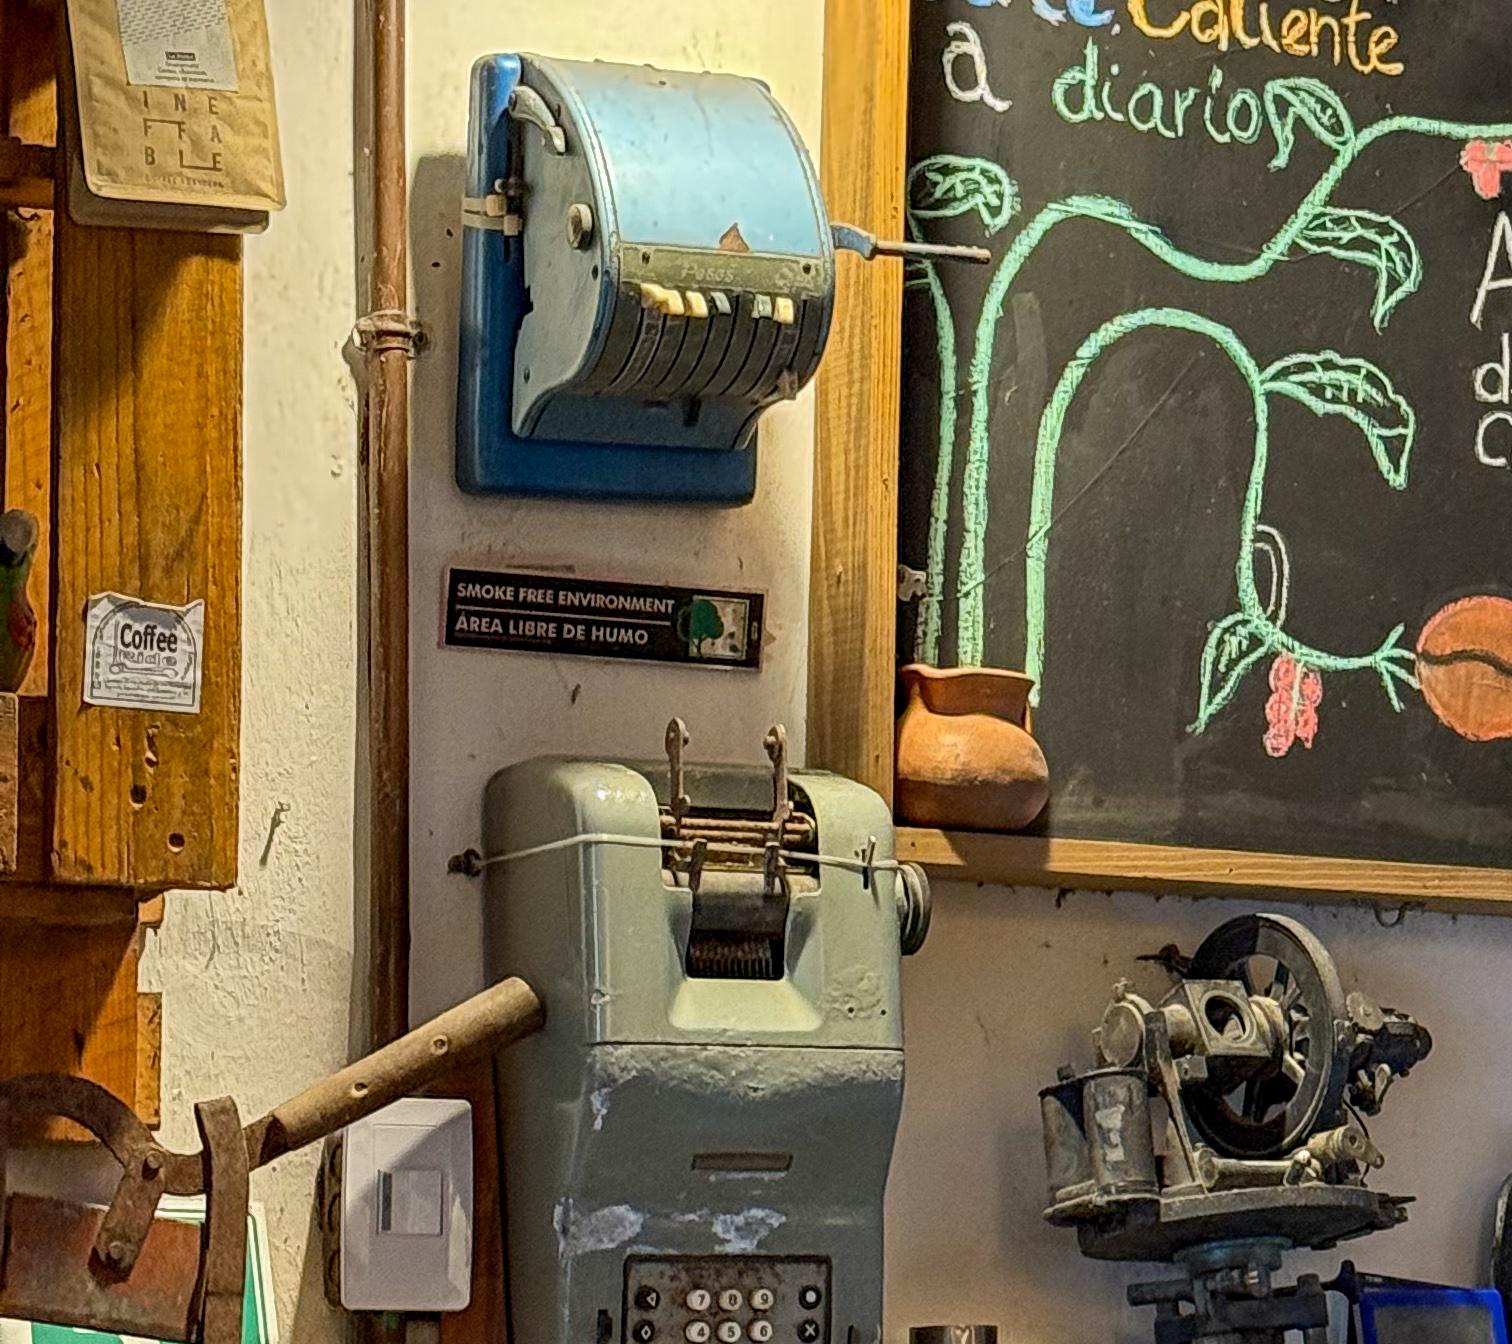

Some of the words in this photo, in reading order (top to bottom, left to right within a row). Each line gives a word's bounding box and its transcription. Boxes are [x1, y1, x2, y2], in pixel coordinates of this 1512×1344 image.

[942, 22, 1013, 111] a
[1051, 36, 1262, 144] diario
[457, 583, 515, 602] SMOKE
[519, 587, 554, 604] FREE
[558, 591, 675, 614] ENVIRONMENT
[120, 623, 178, 653] Coffee
[455, 611, 503, 634] ÁREA
[509, 620, 558, 639] LIBRE
[563, 623, 586, 641] DE
[591, 626, 649, 645] HUMO
